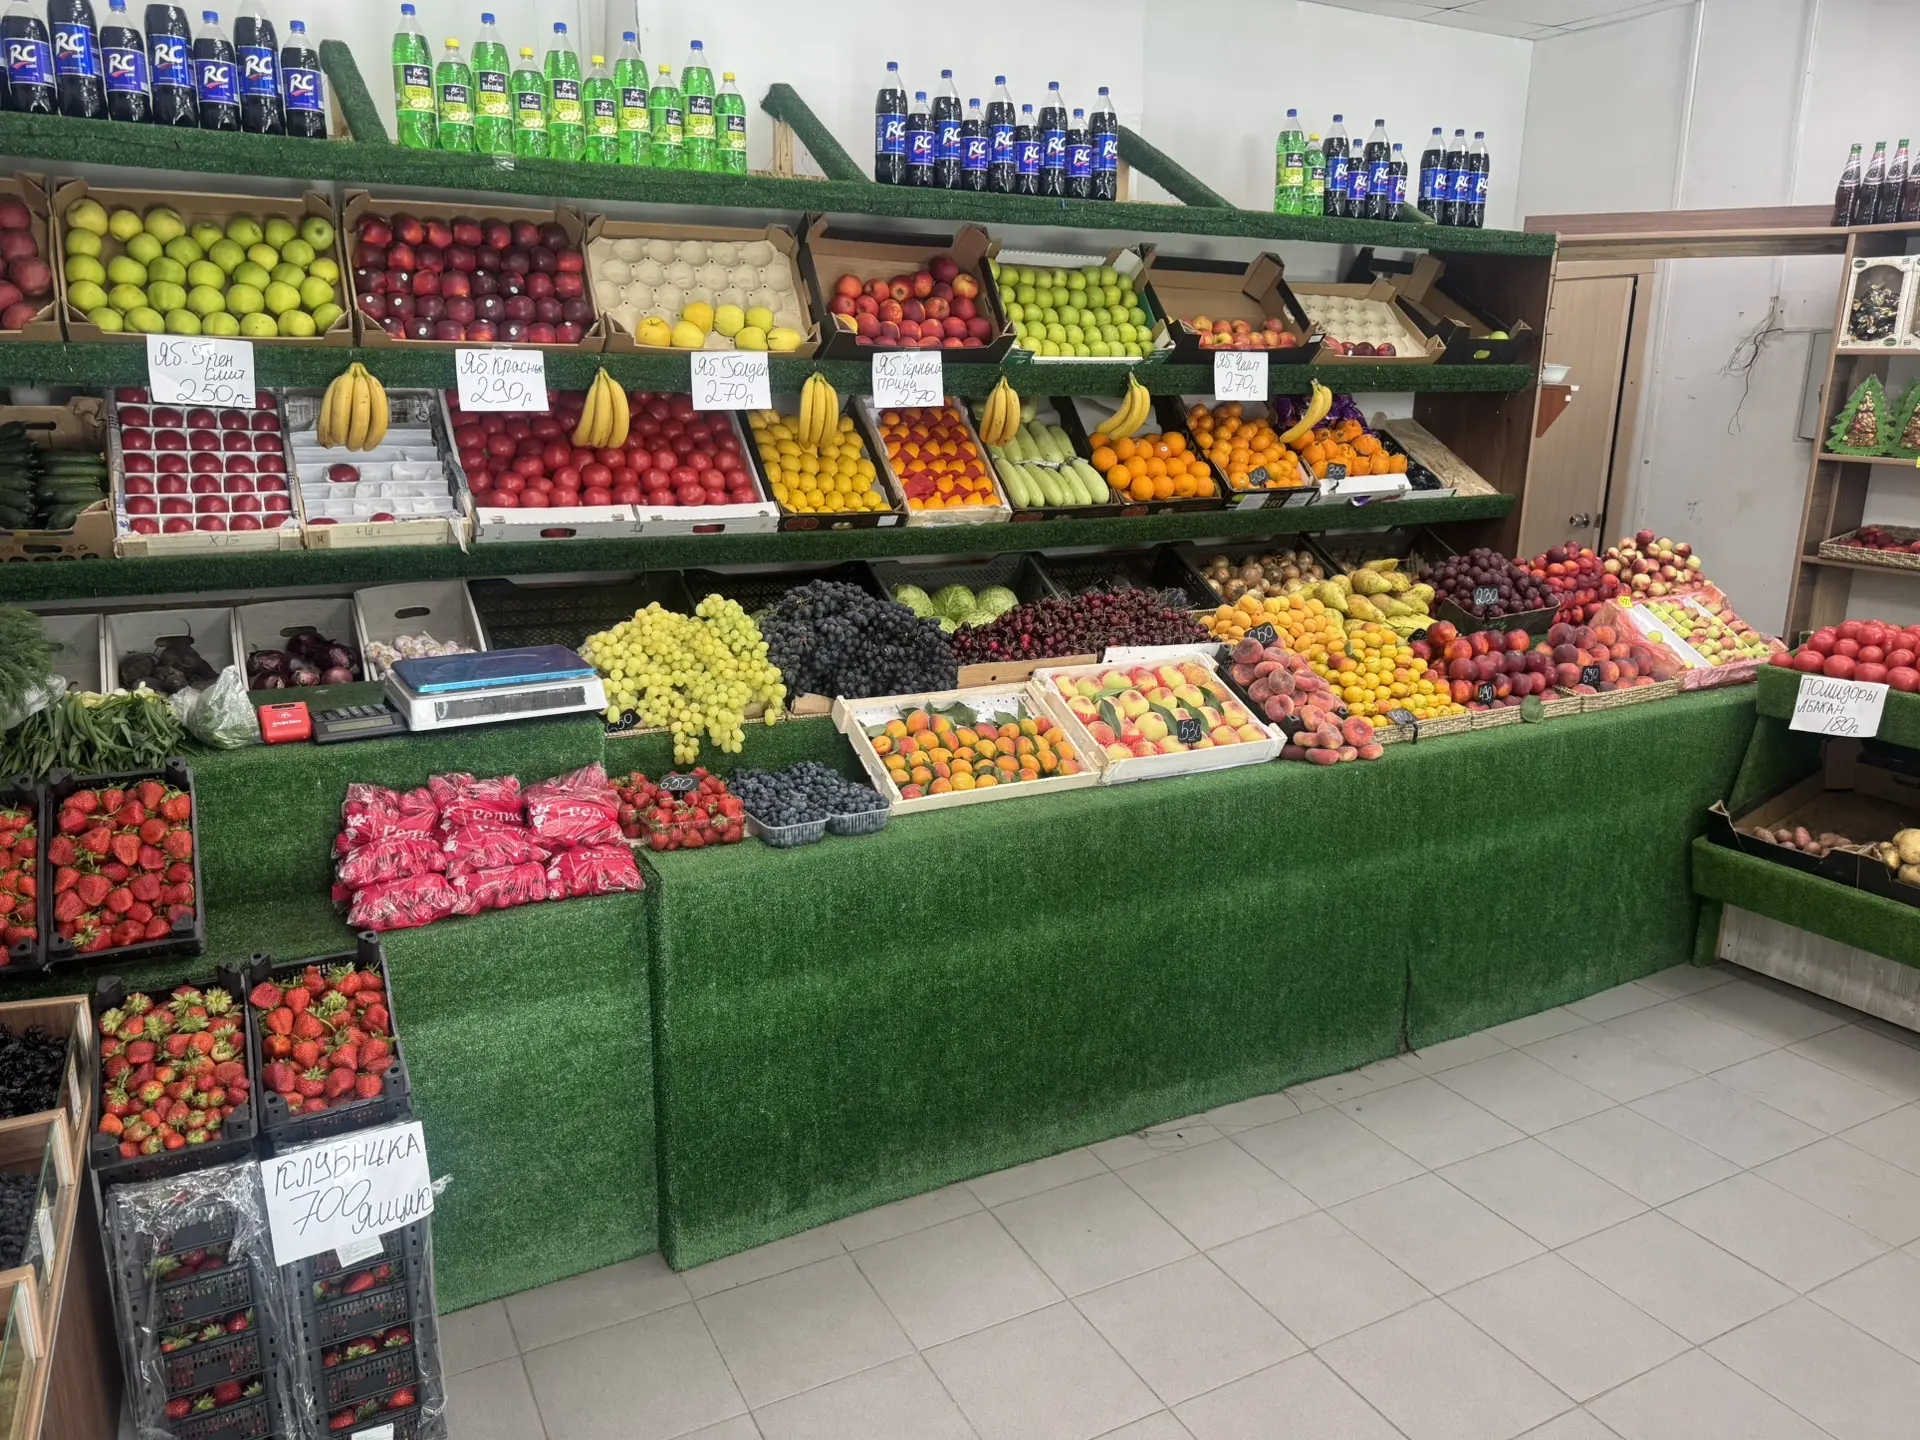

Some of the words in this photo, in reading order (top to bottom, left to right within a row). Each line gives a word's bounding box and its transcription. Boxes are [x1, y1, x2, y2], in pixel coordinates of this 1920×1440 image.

[56, 32, 85, 54] RC
[10, 44, 37, 65] RC
[109, 53, 135, 73] RC
[155, 43, 183, 65] RC
[204, 65, 229, 84] RC
[245, 55, 273, 76] RC
[290, 73, 313, 92] RC
[886, 121, 905, 139] RC
[943, 128, 961, 145] RC
[914, 136, 932, 152] RC
[969, 141, 986, 157] RC
[995, 132, 1013, 149] RC
[1047, 138, 1065, 155] RC
[1103, 141, 1117, 156] RC
[1024, 146, 1039, 162] RC
[1074, 149, 1090, 165] RC
[470, 376, 532, 407] 290р
[705, 379, 754, 408] 270р
[1222, 371, 1258, 398] 270р
[894, 389, 937, 407] 270
[1476, 588, 1498, 604] 230
[1478, 685, 1492, 701] 490
[1179, 720, 1201, 741] 530
[1821, 716, 1859, 735] 180р
[660, 776, 693, 790] 650
[289, 1178, 372, 1236] 700
